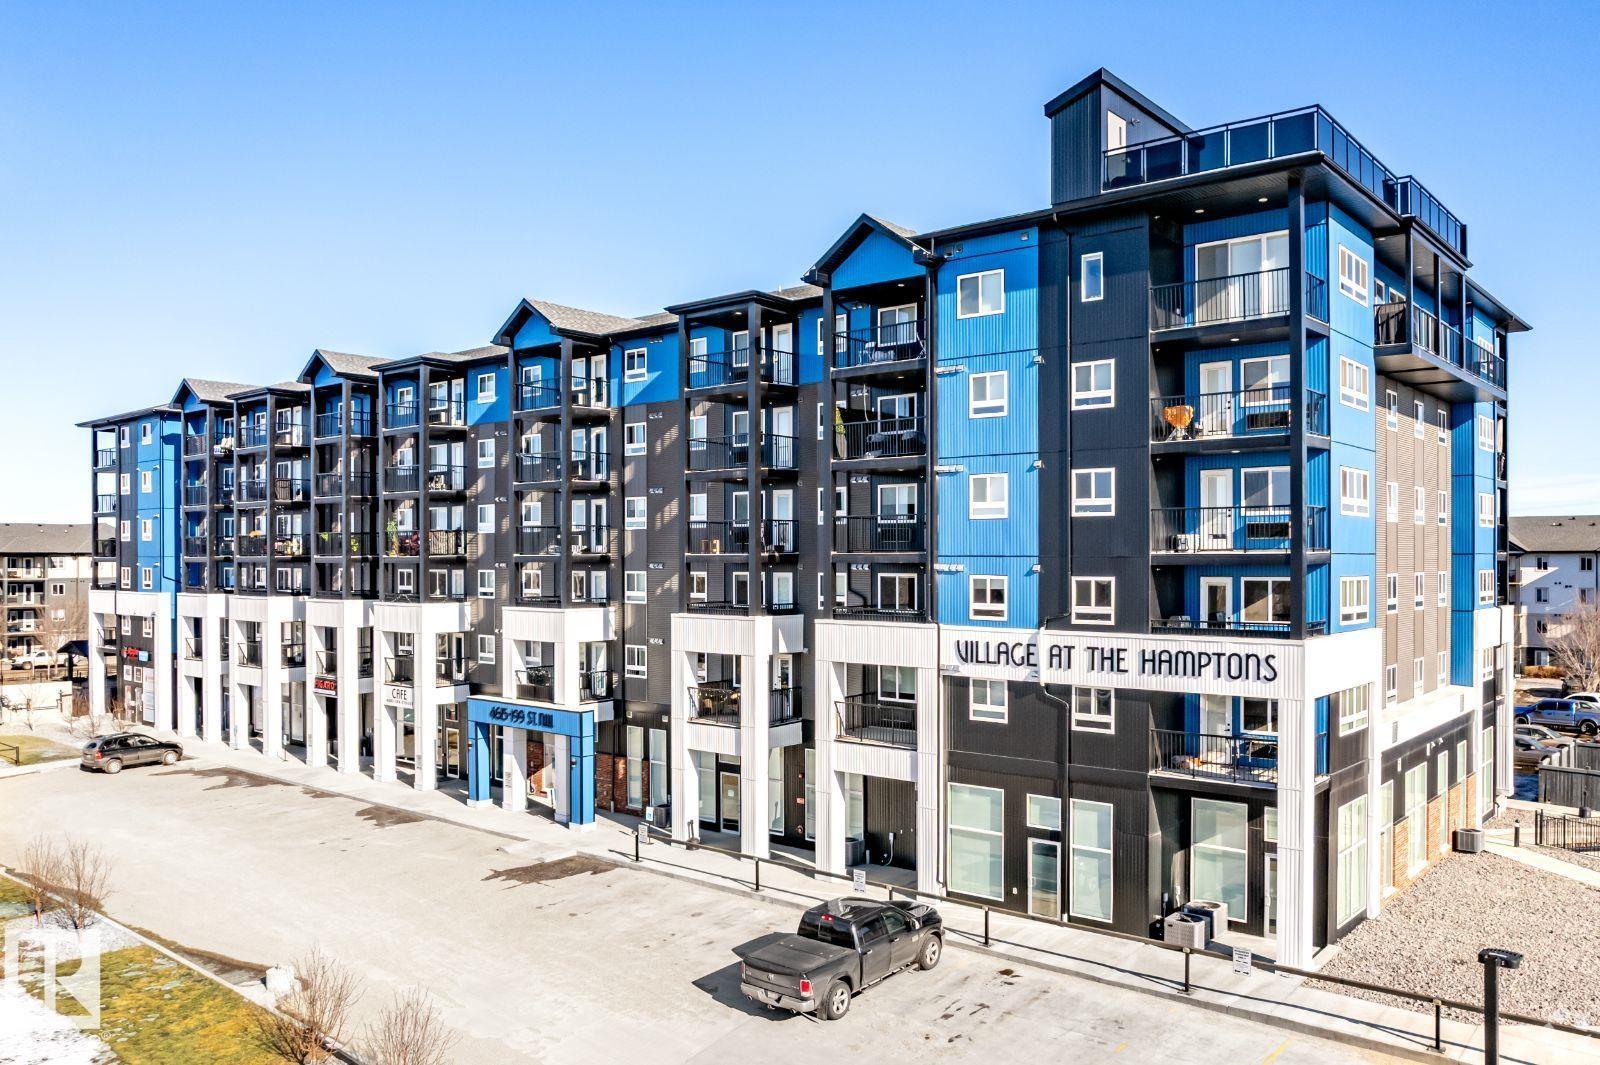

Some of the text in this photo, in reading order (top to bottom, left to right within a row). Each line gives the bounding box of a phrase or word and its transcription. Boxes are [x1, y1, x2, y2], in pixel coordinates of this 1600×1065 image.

[956, 639, 1278, 682] VILLAGE AT THE HAMPTONS
[391, 688, 408, 701] CAFE
